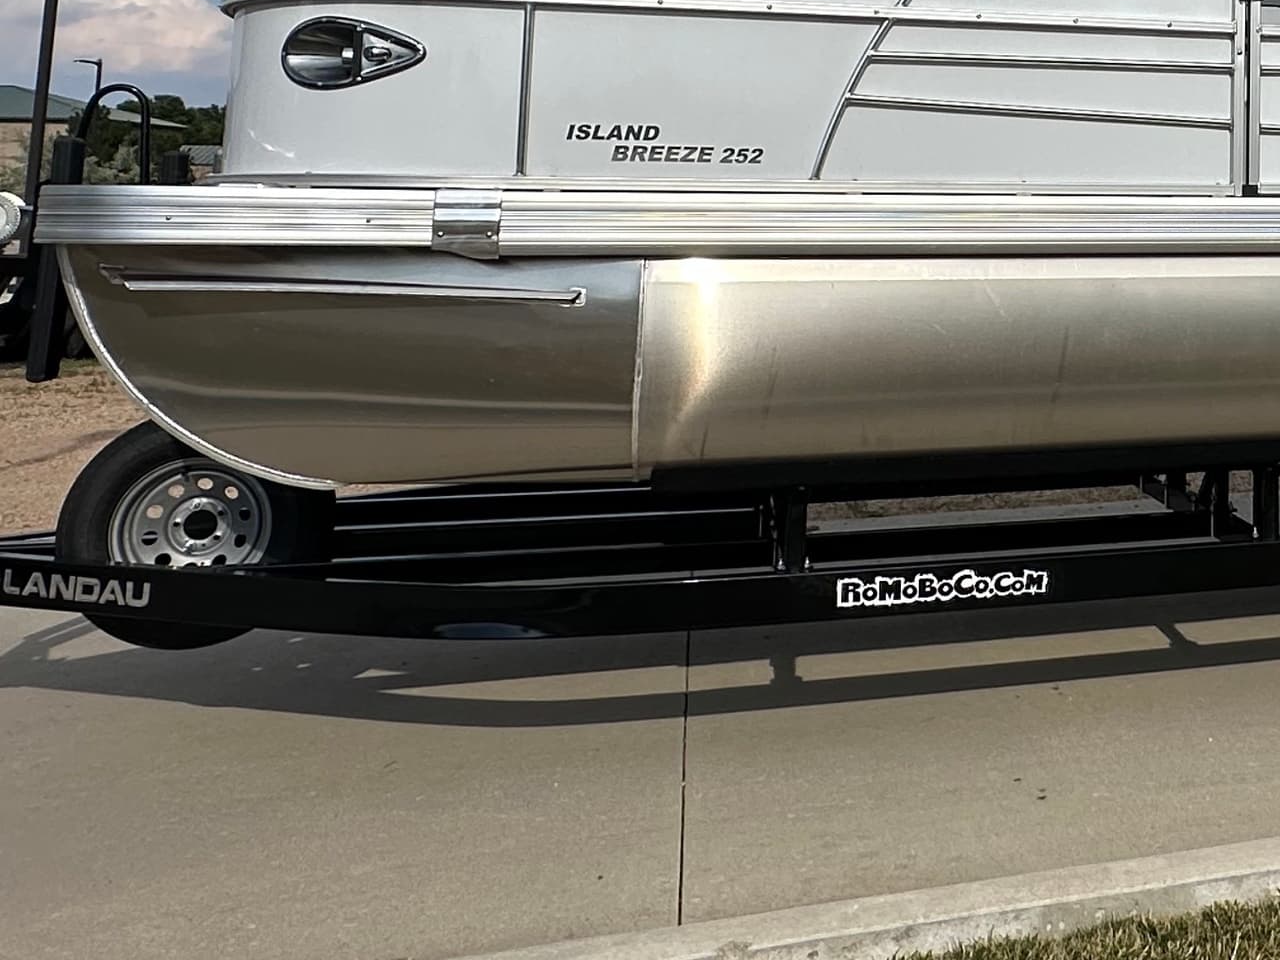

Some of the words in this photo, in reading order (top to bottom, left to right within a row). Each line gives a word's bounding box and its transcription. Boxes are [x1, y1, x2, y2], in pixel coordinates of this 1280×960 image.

[566, 124, 660, 141] ISLAND
[611, 145, 715, 162] BREEZE
[719, 147, 764, 164] 252
[2, 568, 151, 608] LANDAU
